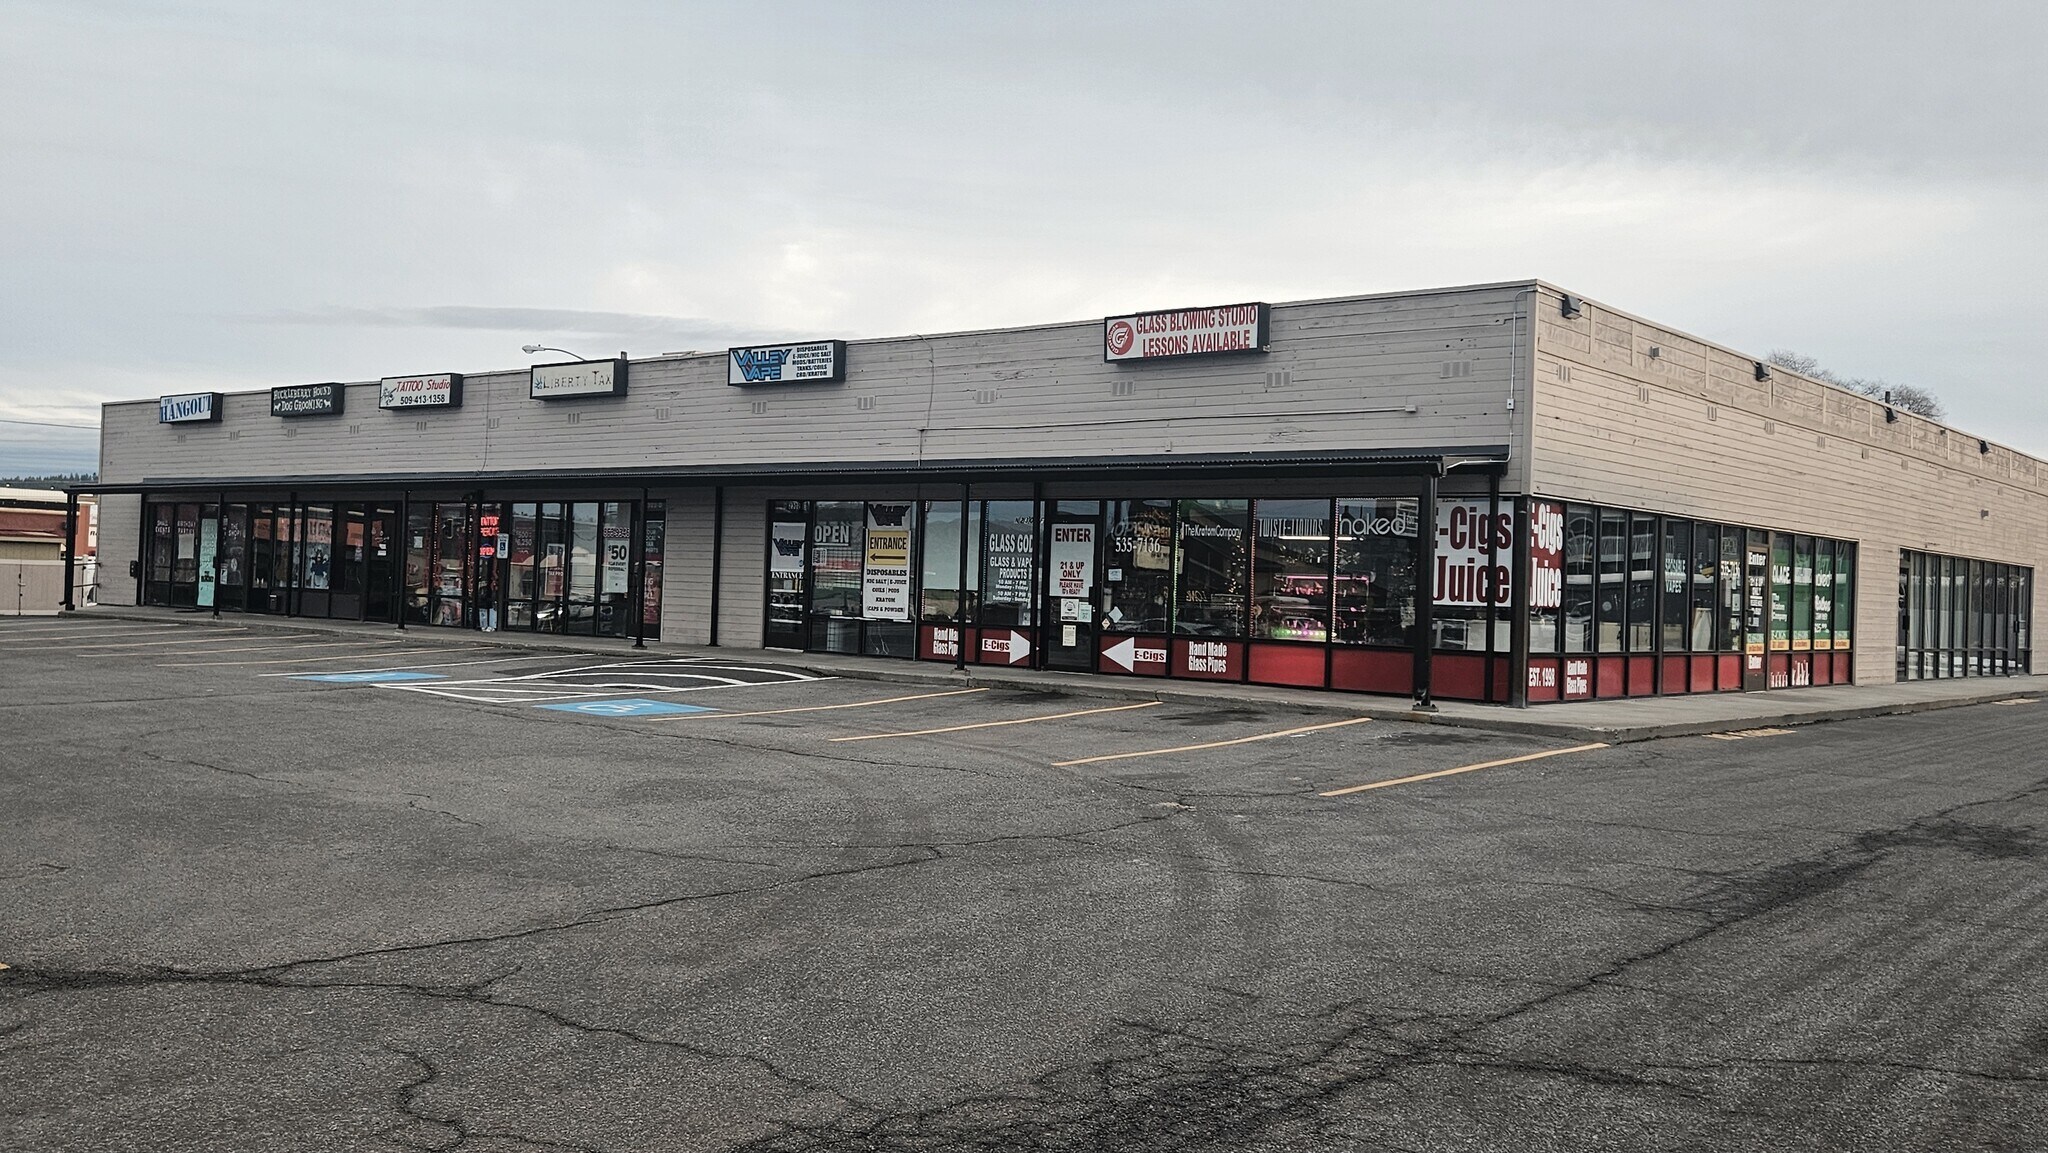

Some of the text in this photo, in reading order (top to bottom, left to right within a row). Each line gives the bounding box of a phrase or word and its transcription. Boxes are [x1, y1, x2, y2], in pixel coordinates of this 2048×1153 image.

[1136, 304, 1257, 335] GLASS BLOWING STUDIO
[1143, 330, 1250, 358] LESSONS AVAILABLE
[732, 348, 792, 367] VALLEY
[741, 364, 782, 381] VAPE
[273, 386, 332, 400] HUCKLEBERRY HOUND
[396, 379, 451, 392] TATTOO Studio
[281, 399, 324, 412] DOG GROOMING
[400, 394, 446, 405] 509-413-1358
[160, 396, 212, 421] HANGOUT
[1339, 512, 1406, 535] naked
[1434, 506, 1512, 555] -Cigs
[814, 525, 850, 543] OPEN
[1055, 528, 1091, 543] ENTER
[869, 537, 907, 550] ENTRANCE
[989, 533, 1034, 553] GLASS GOD
[1115, 537, 1161, 553] 535-7136
[608, 544, 627, 560] $50
[990, 556, 1033, 568] GLASS & VAPO
[1060, 562, 1068, 570] 21
[1076, 562, 1085, 570] UP
[772, 571, 804, 579] ENTRANCE
[999, 568, 1028, 579] PRODUCTS
[1062, 570, 1081, 578] ONLY
[1432, 555, 1510, 604] Juice
[1530, 557, 1562, 608] Juice
[933, 627, 958, 640] Hand Ma
[933, 640, 958, 657] Glass Pip
[984, 639, 1010, 651] E-Cigs
[1188, 641, 1228, 657] Hand Made
[1134, 650, 1165, 662] E-Cigs
[1188, 656, 1227, 674] Glass Pipes
[1528, 667, 1541, 687] EST.
